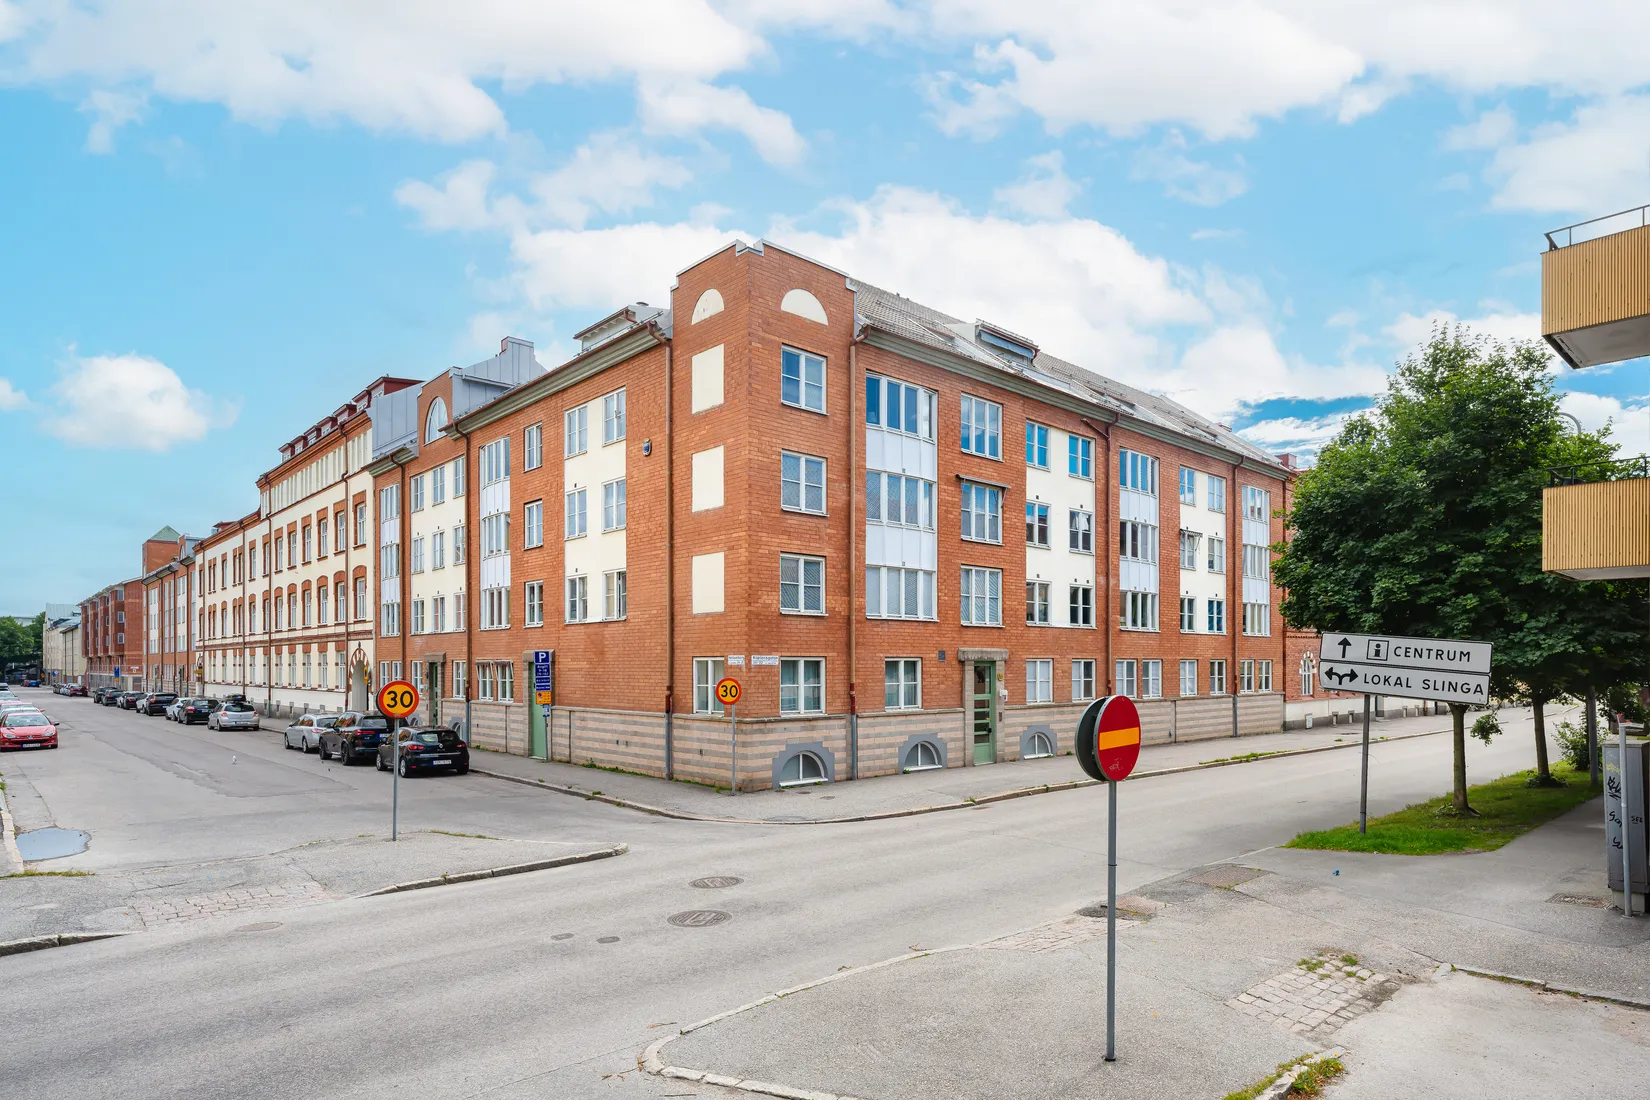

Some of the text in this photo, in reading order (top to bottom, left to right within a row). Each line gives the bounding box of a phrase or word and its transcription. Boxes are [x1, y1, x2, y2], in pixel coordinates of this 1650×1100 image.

[538, 652, 546, 662] P
[1394, 646, 1471, 662] CENTRUM
[720, 684, 738, 698] 30
[1364, 673, 1484, 695] LOKAL SLINGA
[386, 690, 414, 708] 30
